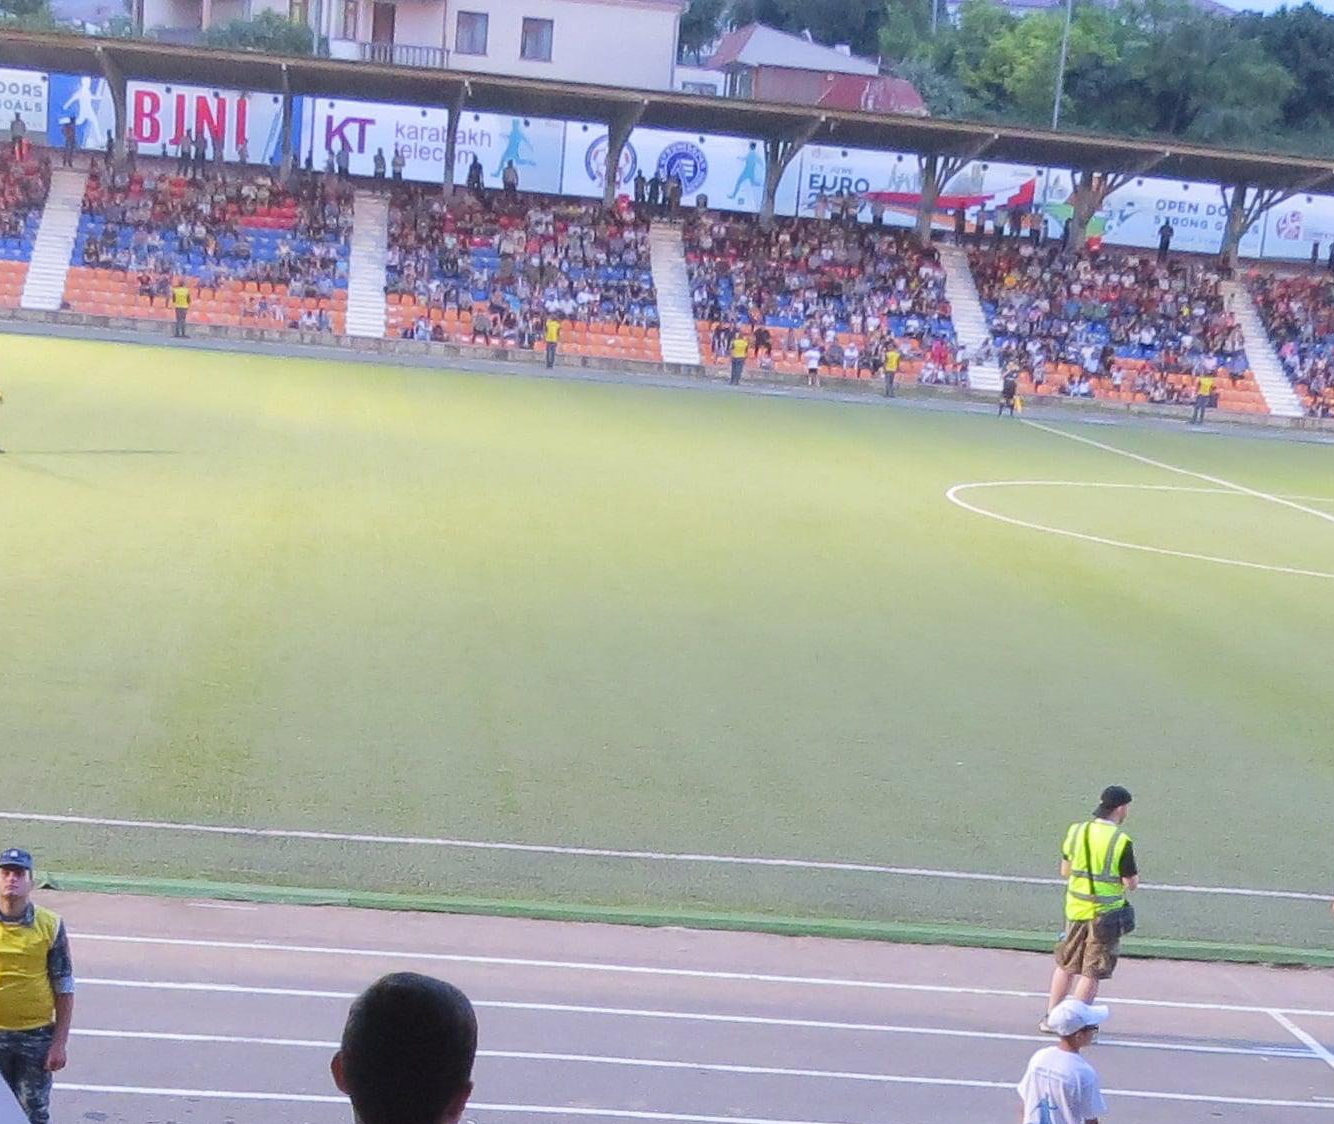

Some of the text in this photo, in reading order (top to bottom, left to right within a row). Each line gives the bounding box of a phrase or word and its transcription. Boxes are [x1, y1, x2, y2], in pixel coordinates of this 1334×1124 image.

[394, 142, 474, 164] telecm
[809, 173, 870, 193] EURO
[1155, 199, 1199, 214] OPEN
[1154, 215, 1208, 230] SRONG
